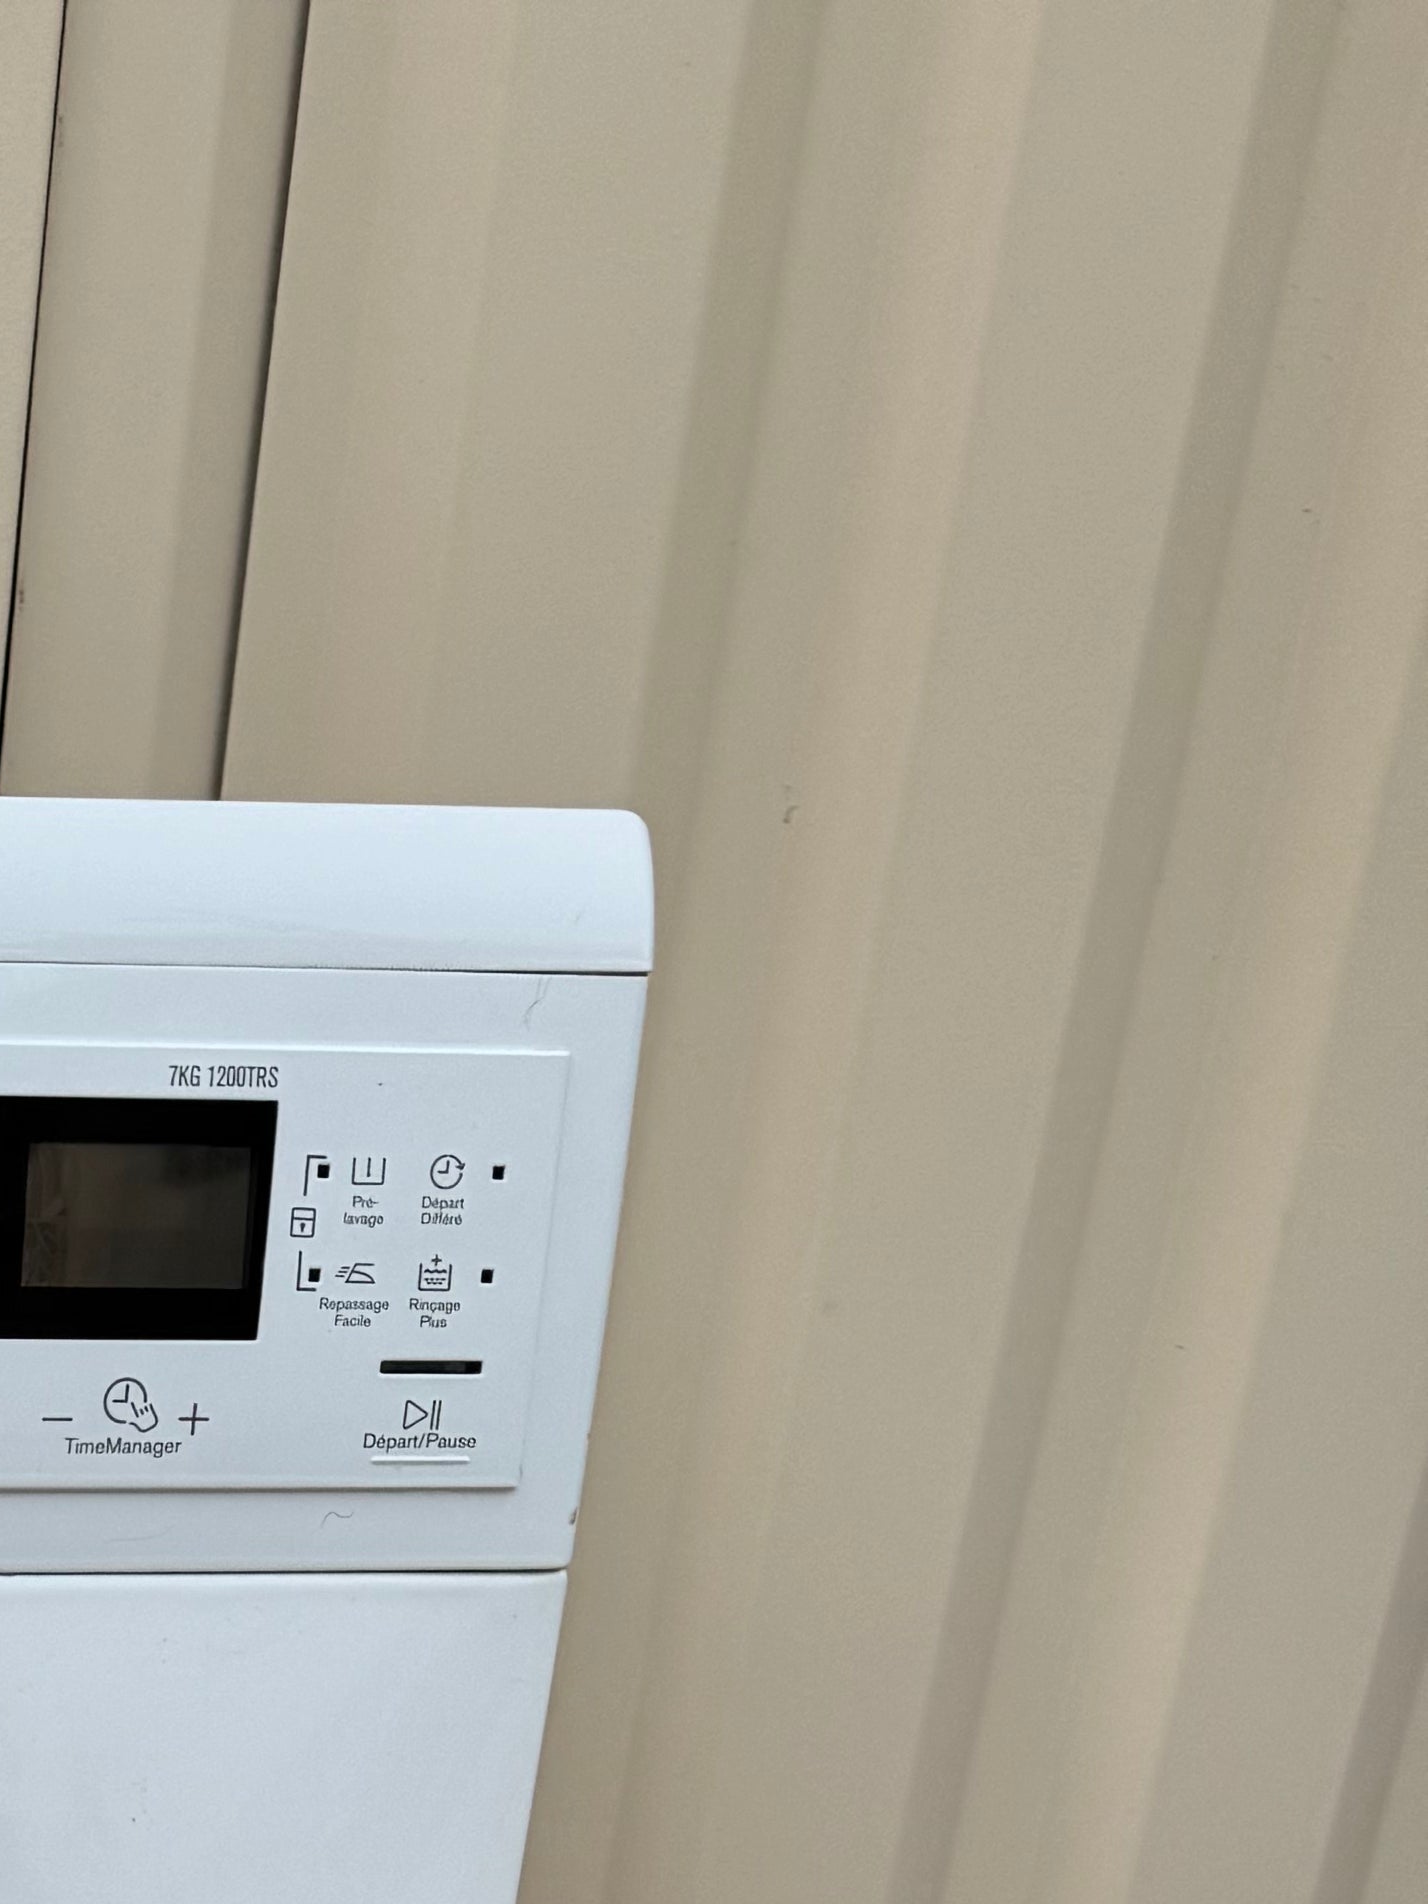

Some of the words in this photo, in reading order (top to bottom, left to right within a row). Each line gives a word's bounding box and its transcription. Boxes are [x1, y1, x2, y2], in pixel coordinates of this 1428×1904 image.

[168, 1065, 201, 1088] 7KG
[206, 1065, 279, 1089] 1200TRS
[422, 1196, 464, 1210] Départ
[344, 1212, 384, 1227] lavage
[421, 1212, 463, 1225] Différé
[319, 1298, 389, 1312] Repassage
[409, 1298, 460, 1314] Rinçage
[334, 1315, 371, 1327] Facile
[420, 1315, 447, 1328] Plus
[64, 1436, 182, 1459] TimeManager
[363, 1431, 477, 1454] Départ/Pause
